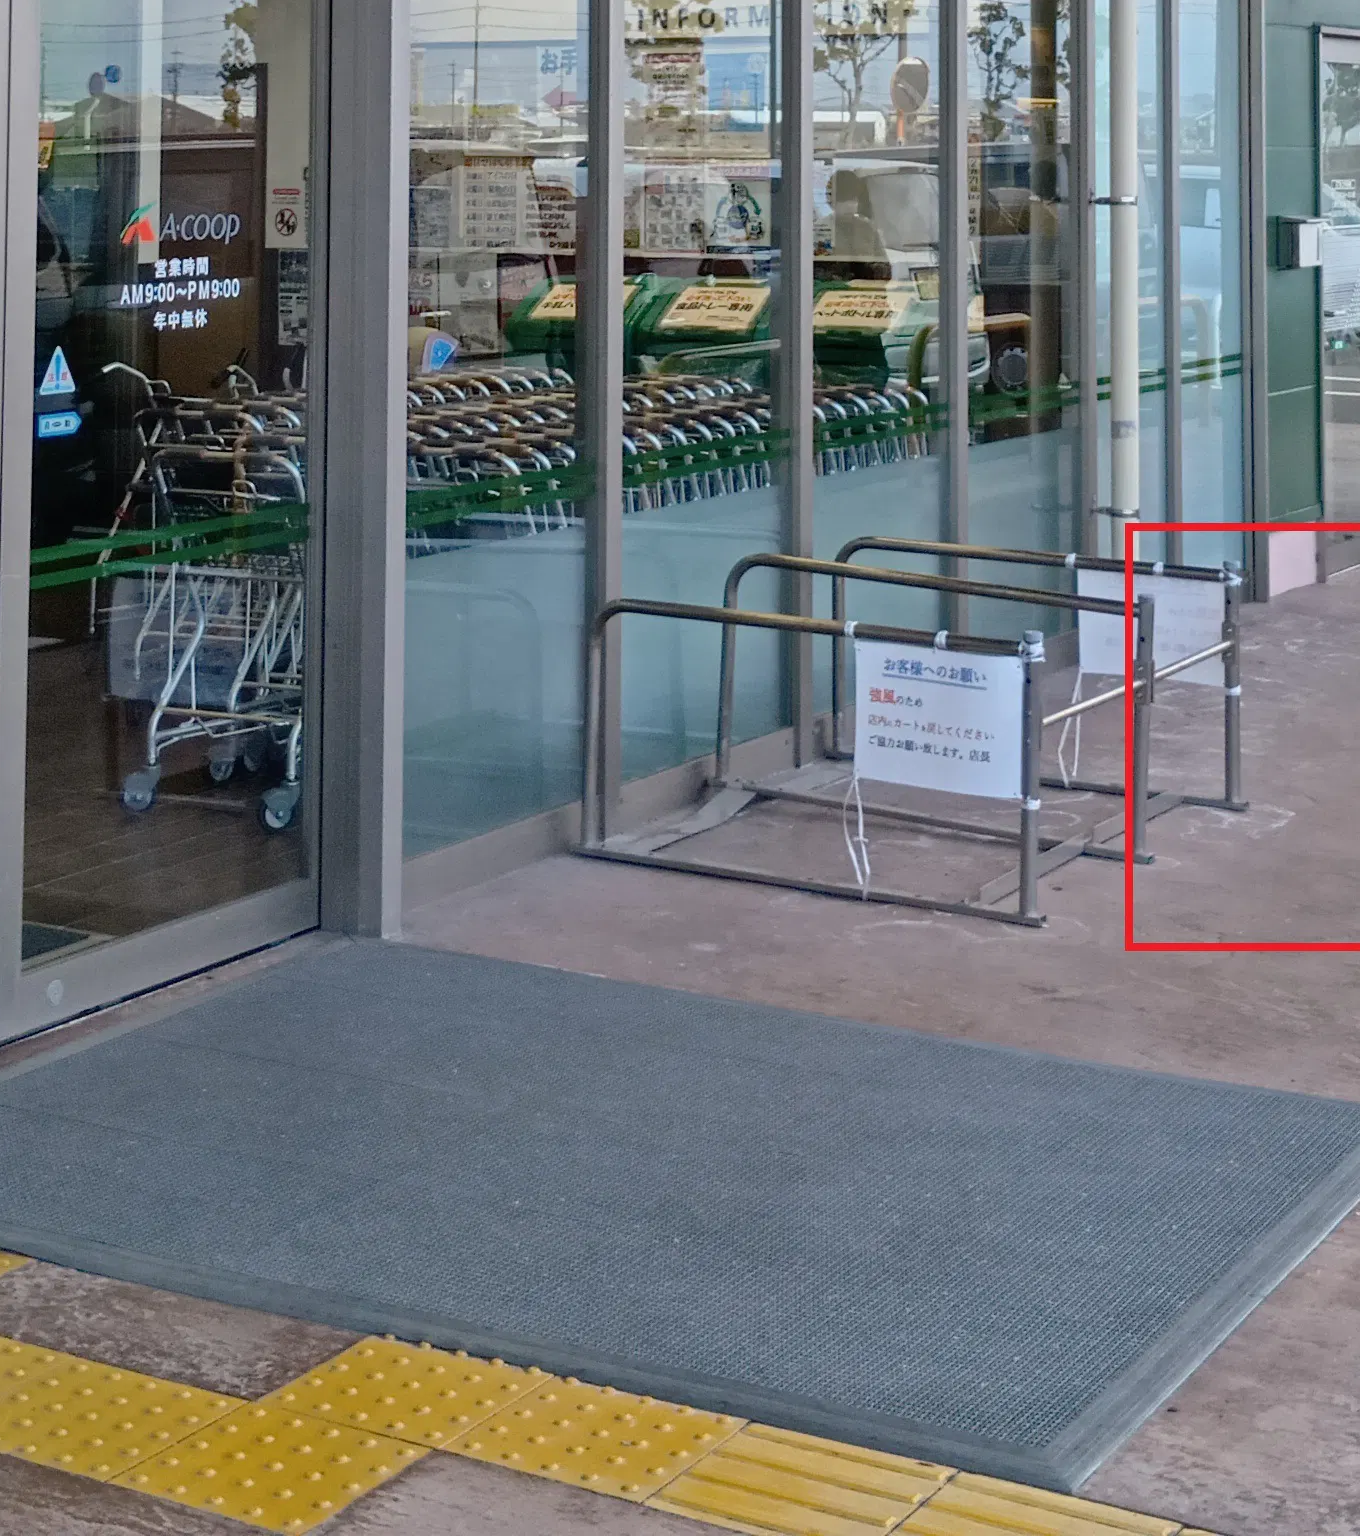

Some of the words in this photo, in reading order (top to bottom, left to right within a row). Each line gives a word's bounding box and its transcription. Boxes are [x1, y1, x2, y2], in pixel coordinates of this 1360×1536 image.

[154, 255, 209, 279] 営業時間
[153, 308, 208, 332] 年中無休
[883, 657, 988, 684] お客様へのお願い
[869, 686, 924, 708] 強風のため
